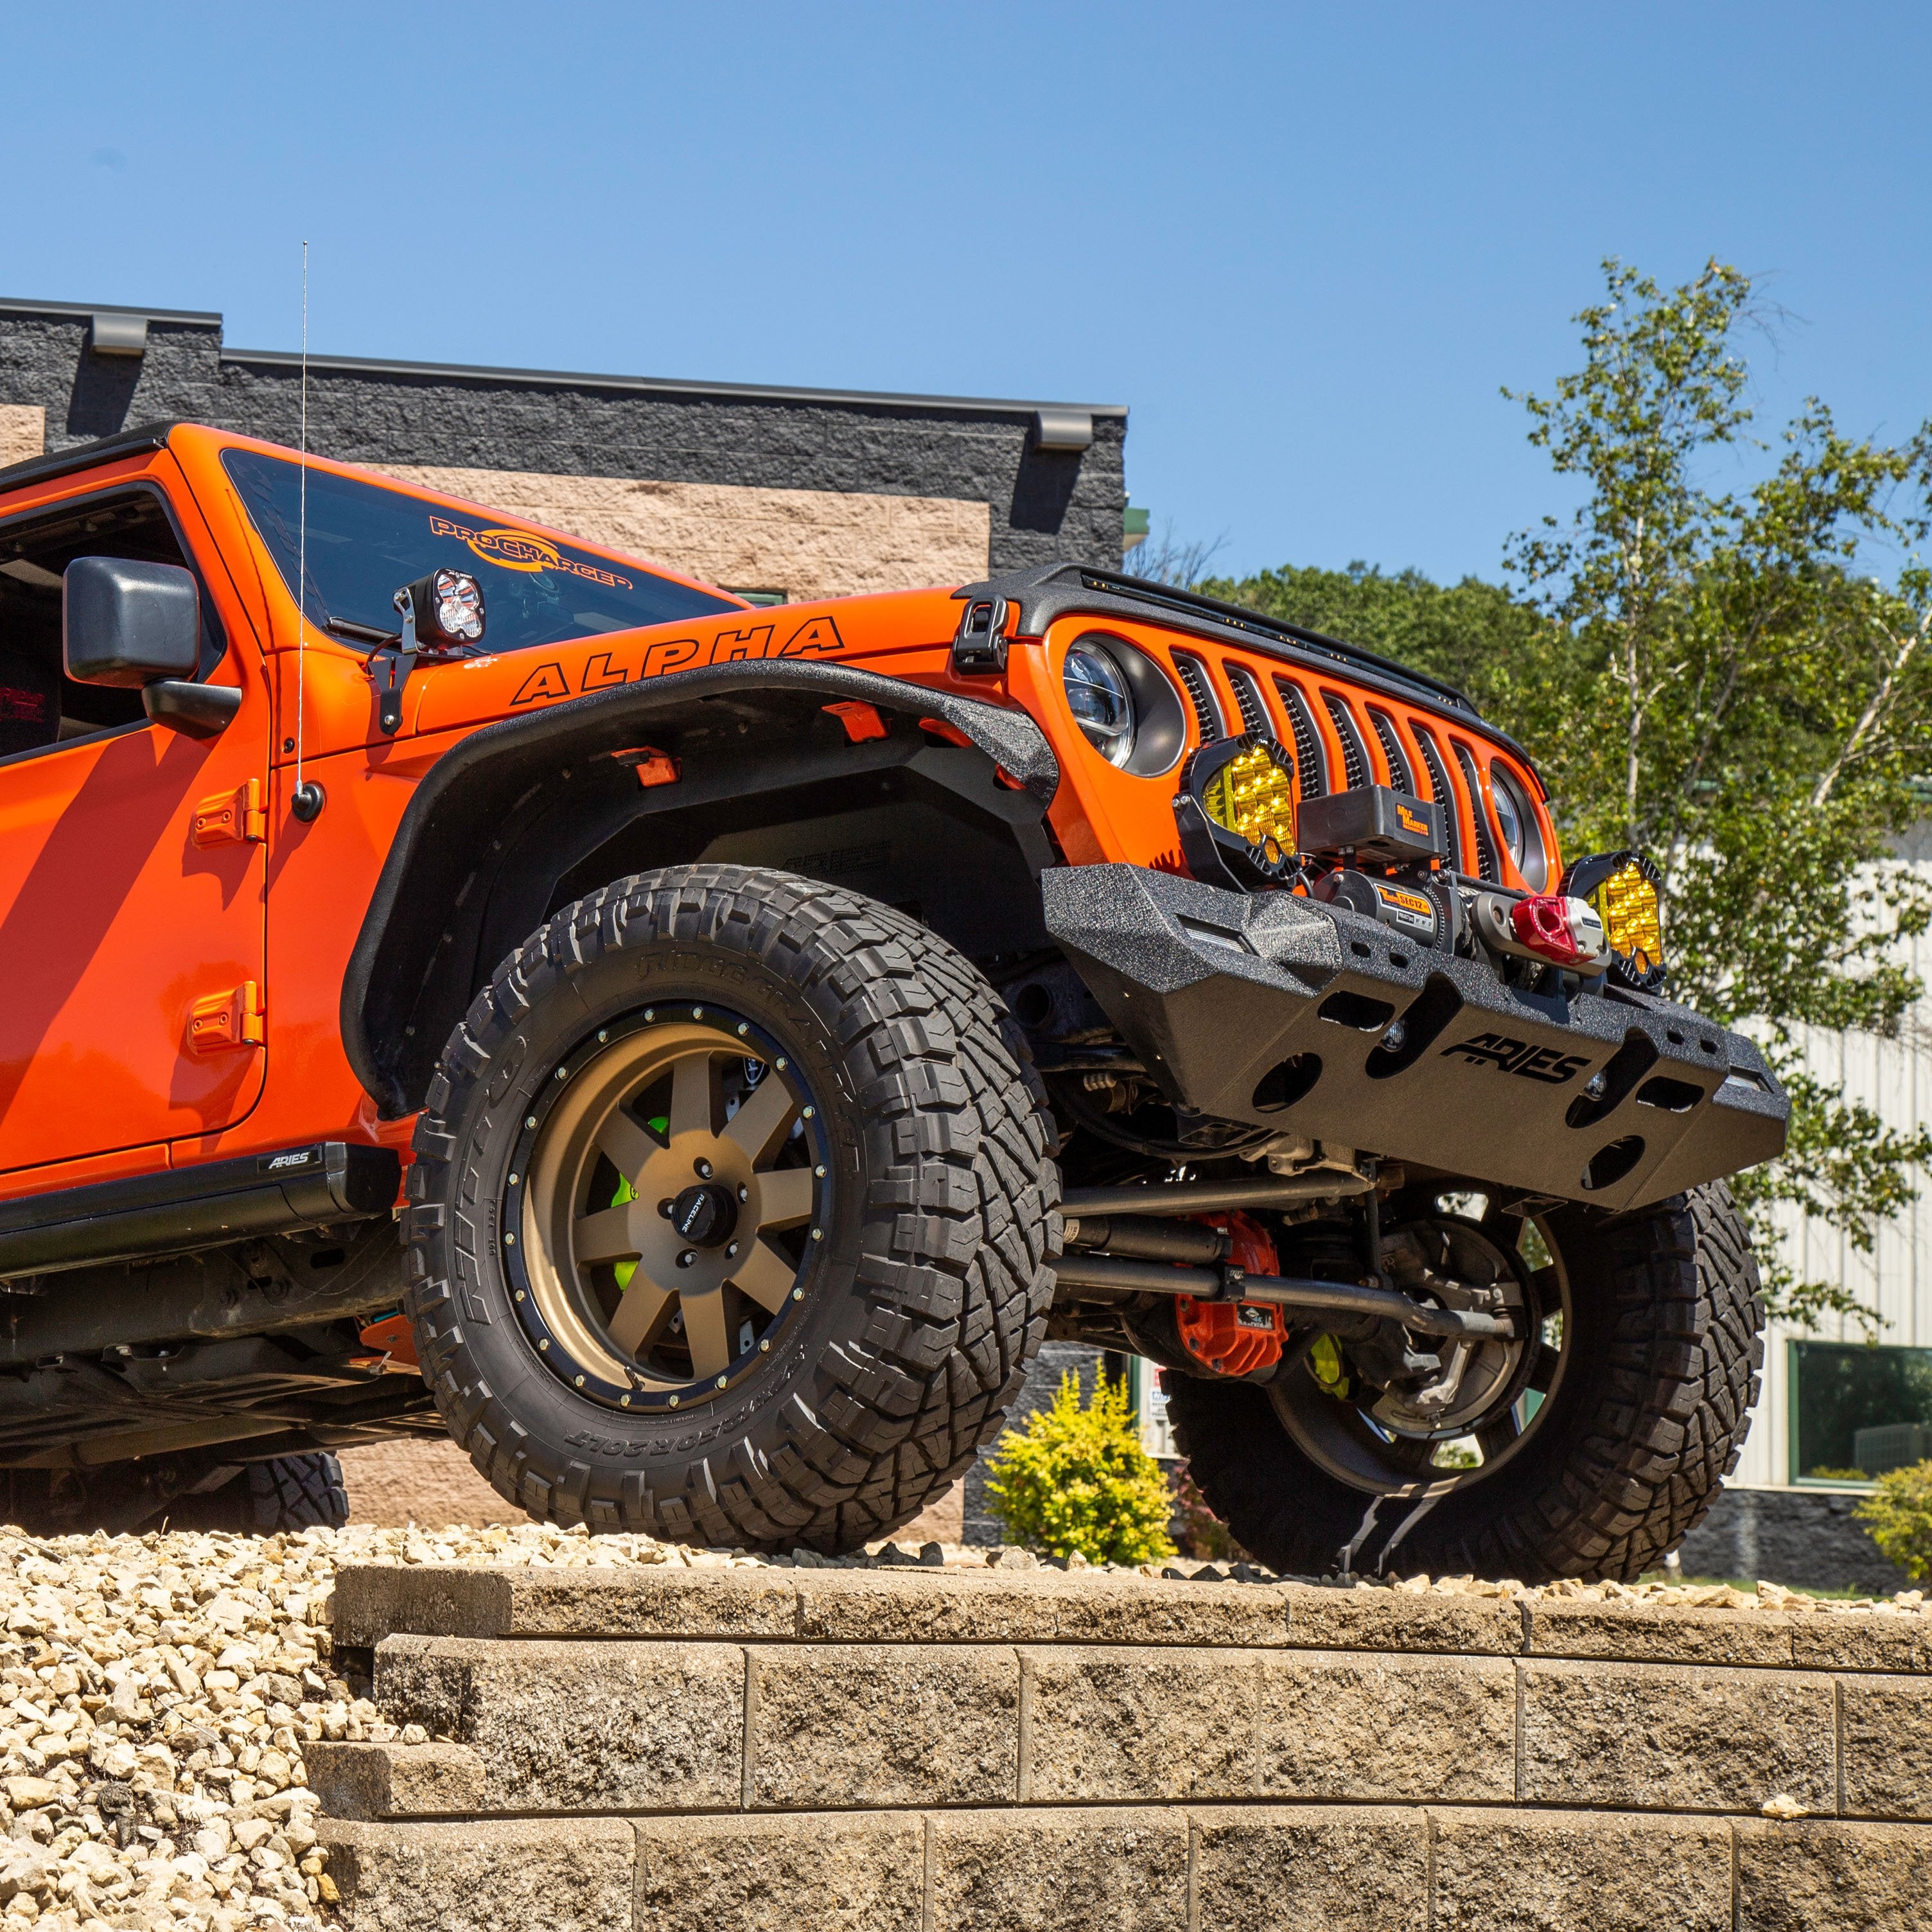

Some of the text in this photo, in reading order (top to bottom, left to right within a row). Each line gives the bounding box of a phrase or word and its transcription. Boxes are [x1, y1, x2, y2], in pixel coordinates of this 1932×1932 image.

[429, 515, 633, 590] PROCHARGER
[509, 615, 845, 707] ALPHA
[1402, 814, 1428, 832] MARKER
[1400, 895, 1423, 909] SEC12
[1439, 1032, 1593, 1084] ARIES
[268, 1152, 310, 1170] ARIES
[681, 1193, 705, 1233] RACELINE
